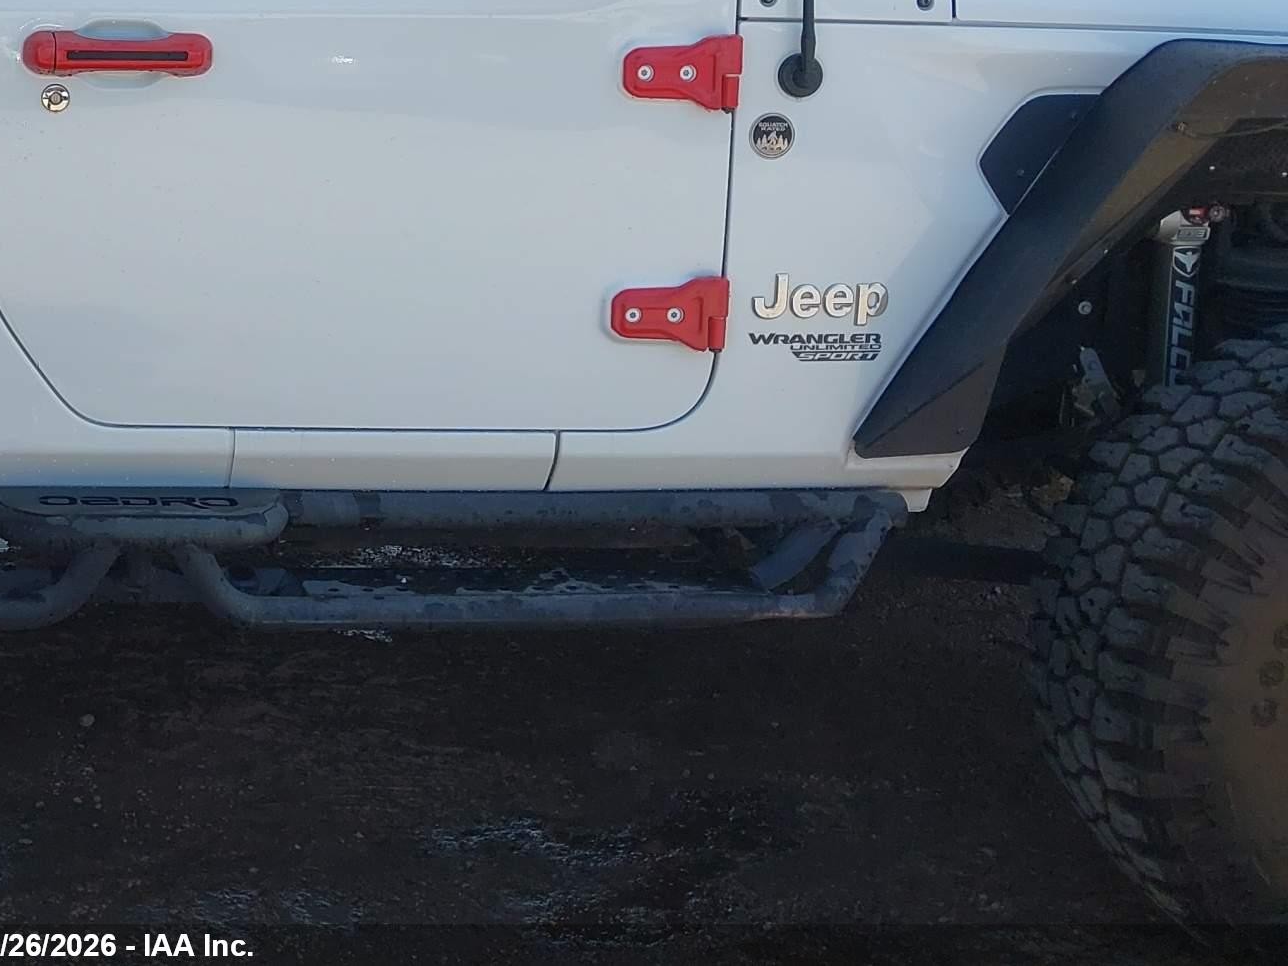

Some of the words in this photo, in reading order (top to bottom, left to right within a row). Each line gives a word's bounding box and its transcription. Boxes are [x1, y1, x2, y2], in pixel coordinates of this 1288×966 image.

[751, 272, 889, 326] Jeep
[748, 333, 882, 345] WRANGLER
[797, 352, 880, 361] SPORT
